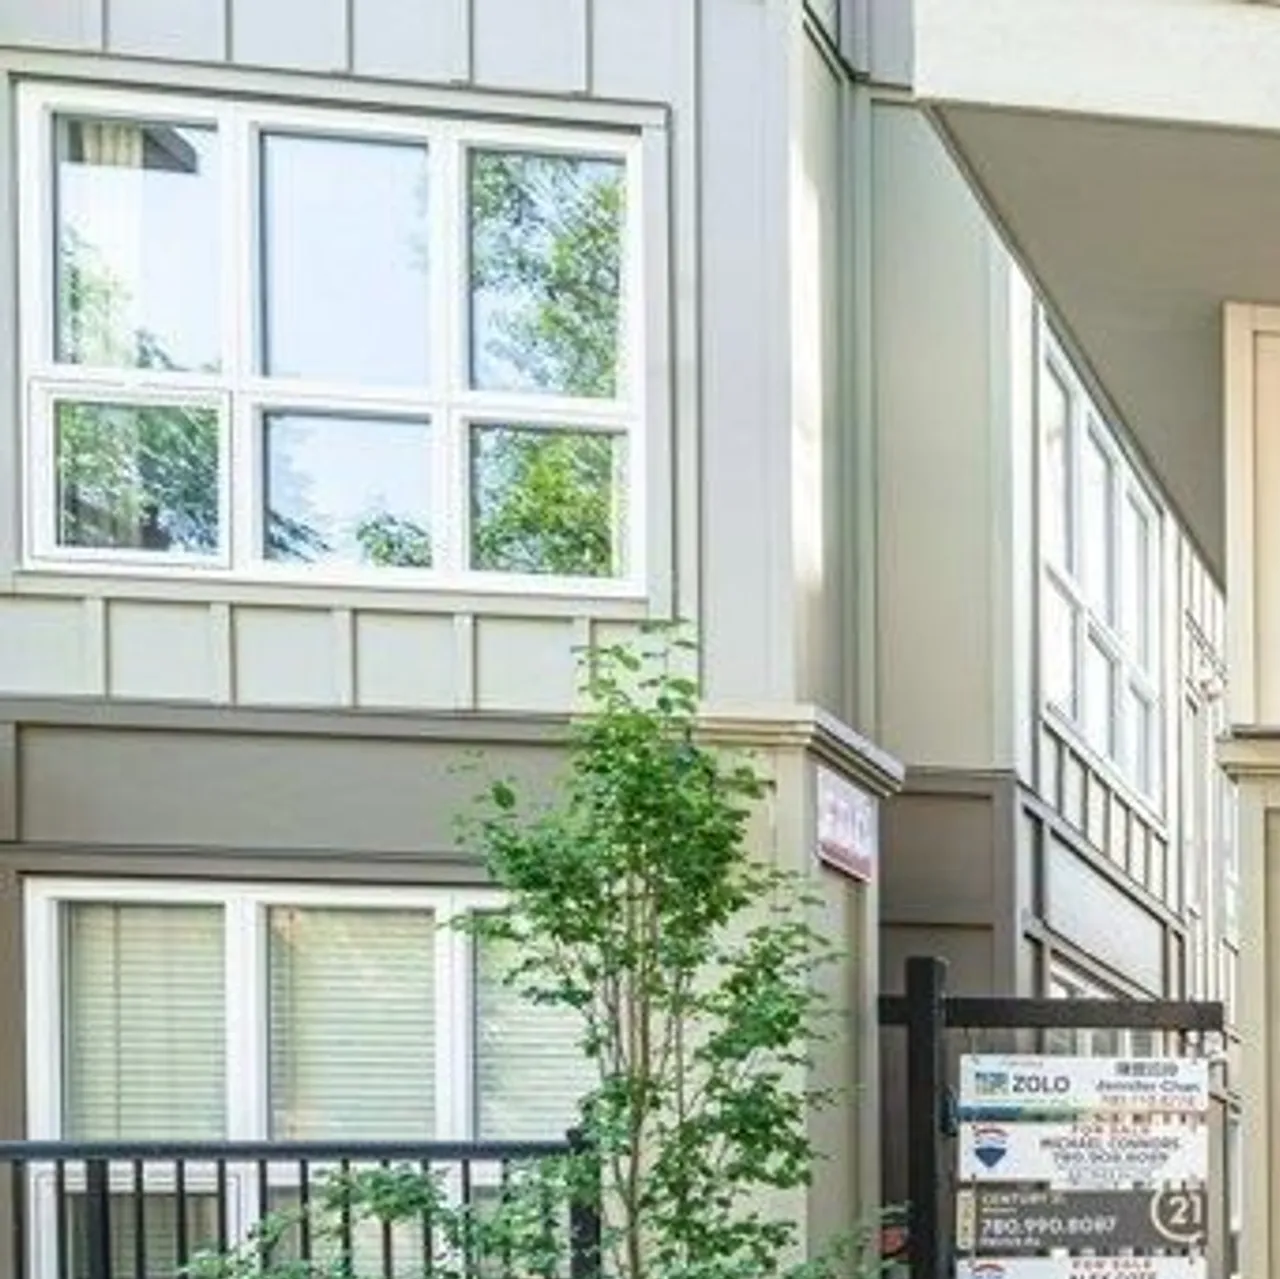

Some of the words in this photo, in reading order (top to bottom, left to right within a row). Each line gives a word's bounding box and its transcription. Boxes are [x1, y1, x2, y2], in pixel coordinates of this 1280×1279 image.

[1012, 1074, 1071, 1093] ZOLO
[1040, 1137, 1104, 1149] MICHAEL
[1107, 1137, 1180, 1149] CONNORS
[982, 1193, 1047, 1205] CENTURY
